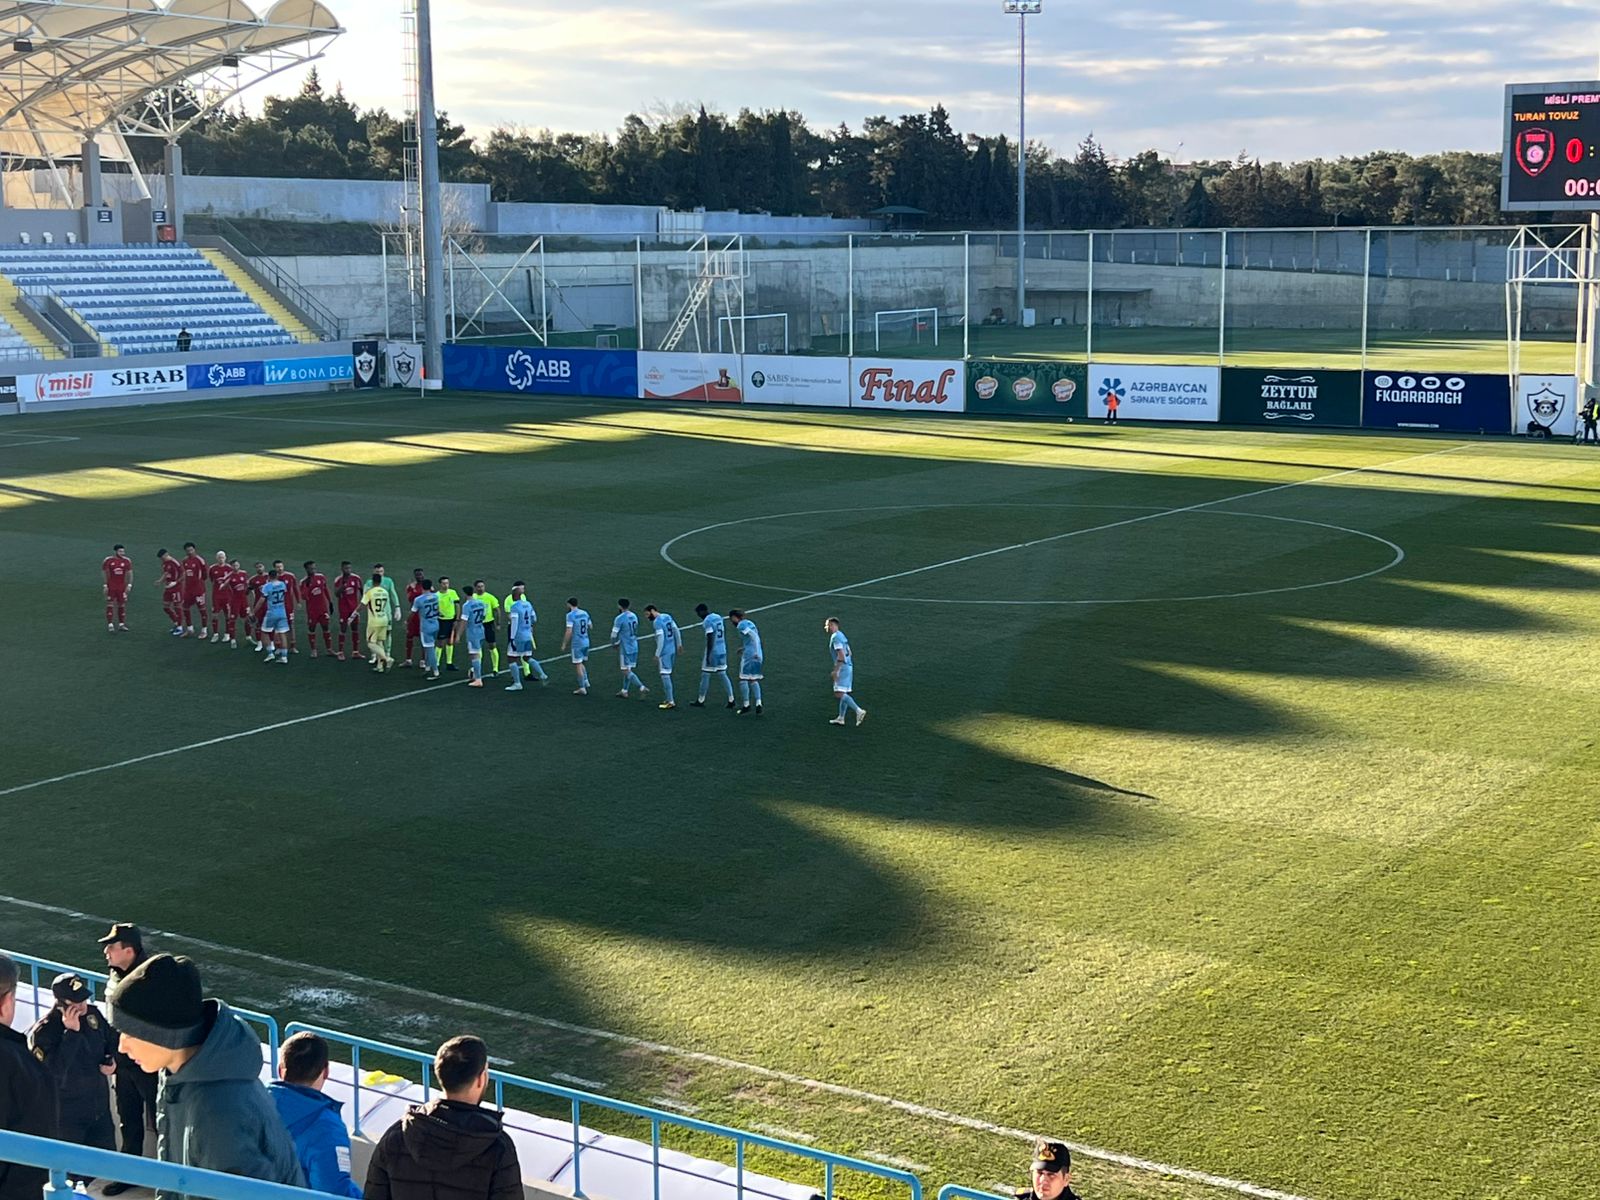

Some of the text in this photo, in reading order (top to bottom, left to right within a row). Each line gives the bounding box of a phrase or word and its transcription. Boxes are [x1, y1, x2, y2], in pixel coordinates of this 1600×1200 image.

[1514, 111, 1579, 121] TURAN TOVUZ
[225, 367, 246, 379] ABB
[290, 367, 326, 380] BONA
[329, 365, 354, 377] DEA
[536, 359, 571, 378] ABB
[48, 373, 93, 391] misli
[111, 369, 184, 386] SİRAB
[859, 367, 956, 404] Final
[1130, 381, 1207, 394] AZƏRBAYCAN
[1261, 384, 1319, 399] ZEYTUN
[1130, 395, 1208, 406] SƏNAYE SIĞORTA
[1376, 389, 1462, 404] FKQARABAGH
[1266, 401, 1312, 411] BAĞLARI
[375, 598, 387, 613] 97
[424, 602, 440, 619] 25
[523, 610, 530, 625] 4
[579, 619, 587, 635] 8
